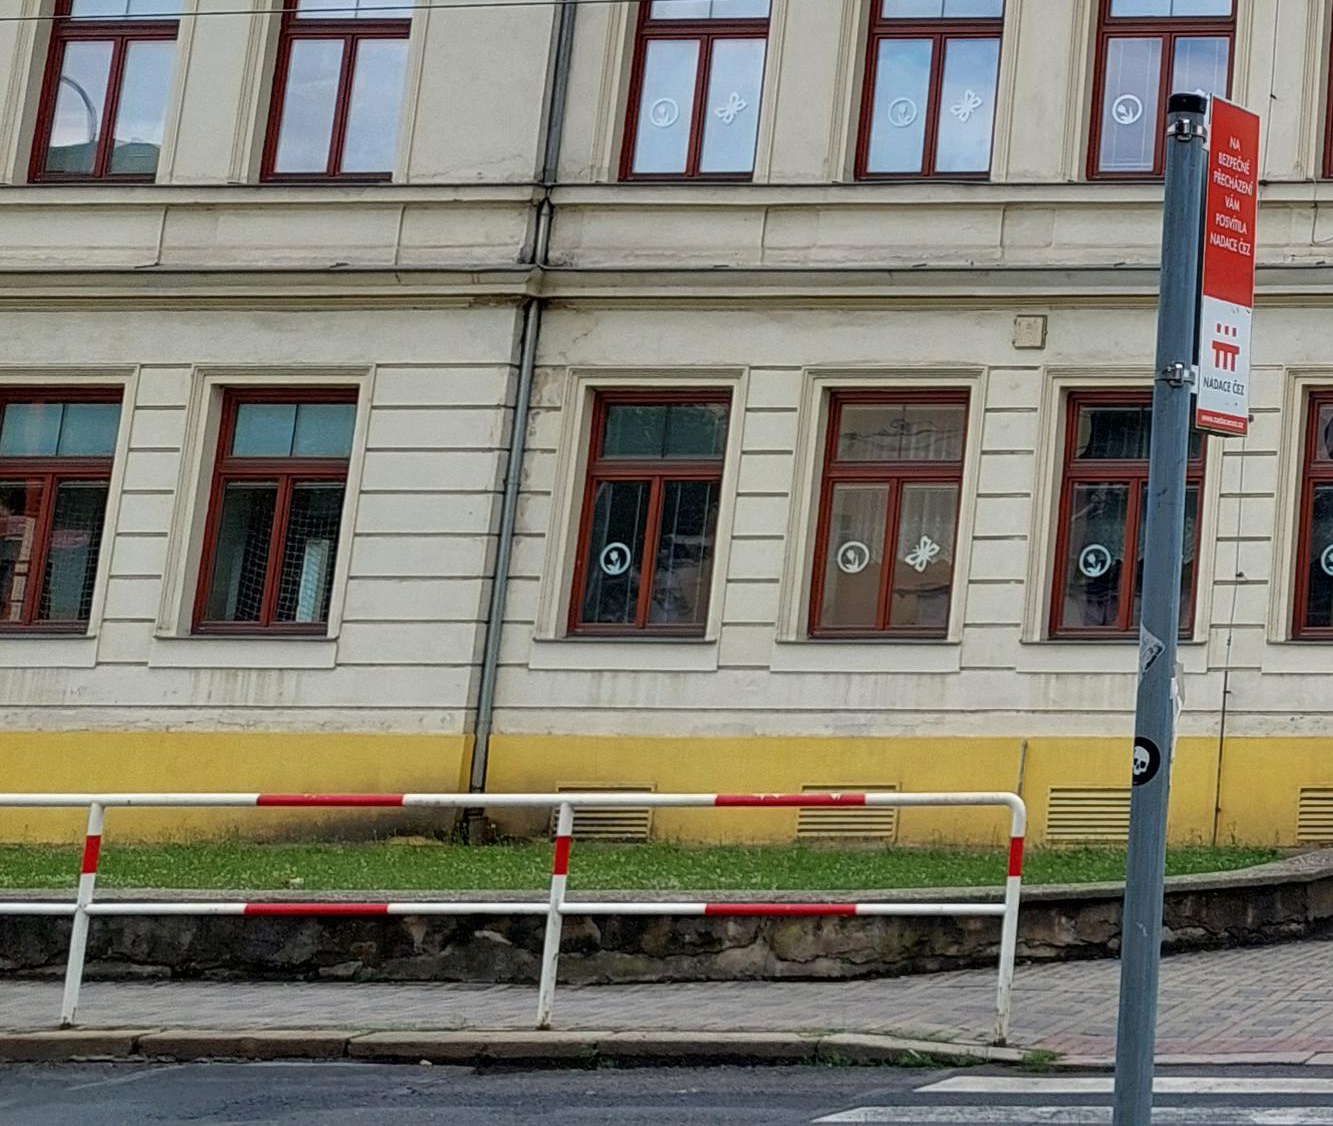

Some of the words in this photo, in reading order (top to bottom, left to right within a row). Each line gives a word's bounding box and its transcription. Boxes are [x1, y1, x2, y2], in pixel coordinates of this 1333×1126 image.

[1229, 135, 1241, 152] NA
[1218, 151, 1250, 175] BEZPEČNÉ
[1213, 168, 1253, 196] PŘECHÁZENÍ
[1224, 193, 1240, 212] VÁM
[1215, 212, 1247, 235] POSVÍTILA
[1210, 230, 1238, 252] NADACE
[1238, 237, 1251, 257] ČEZ
[1203, 376, 1231, 393] NADACE
[1232, 379, 1245, 396] ČEZ
